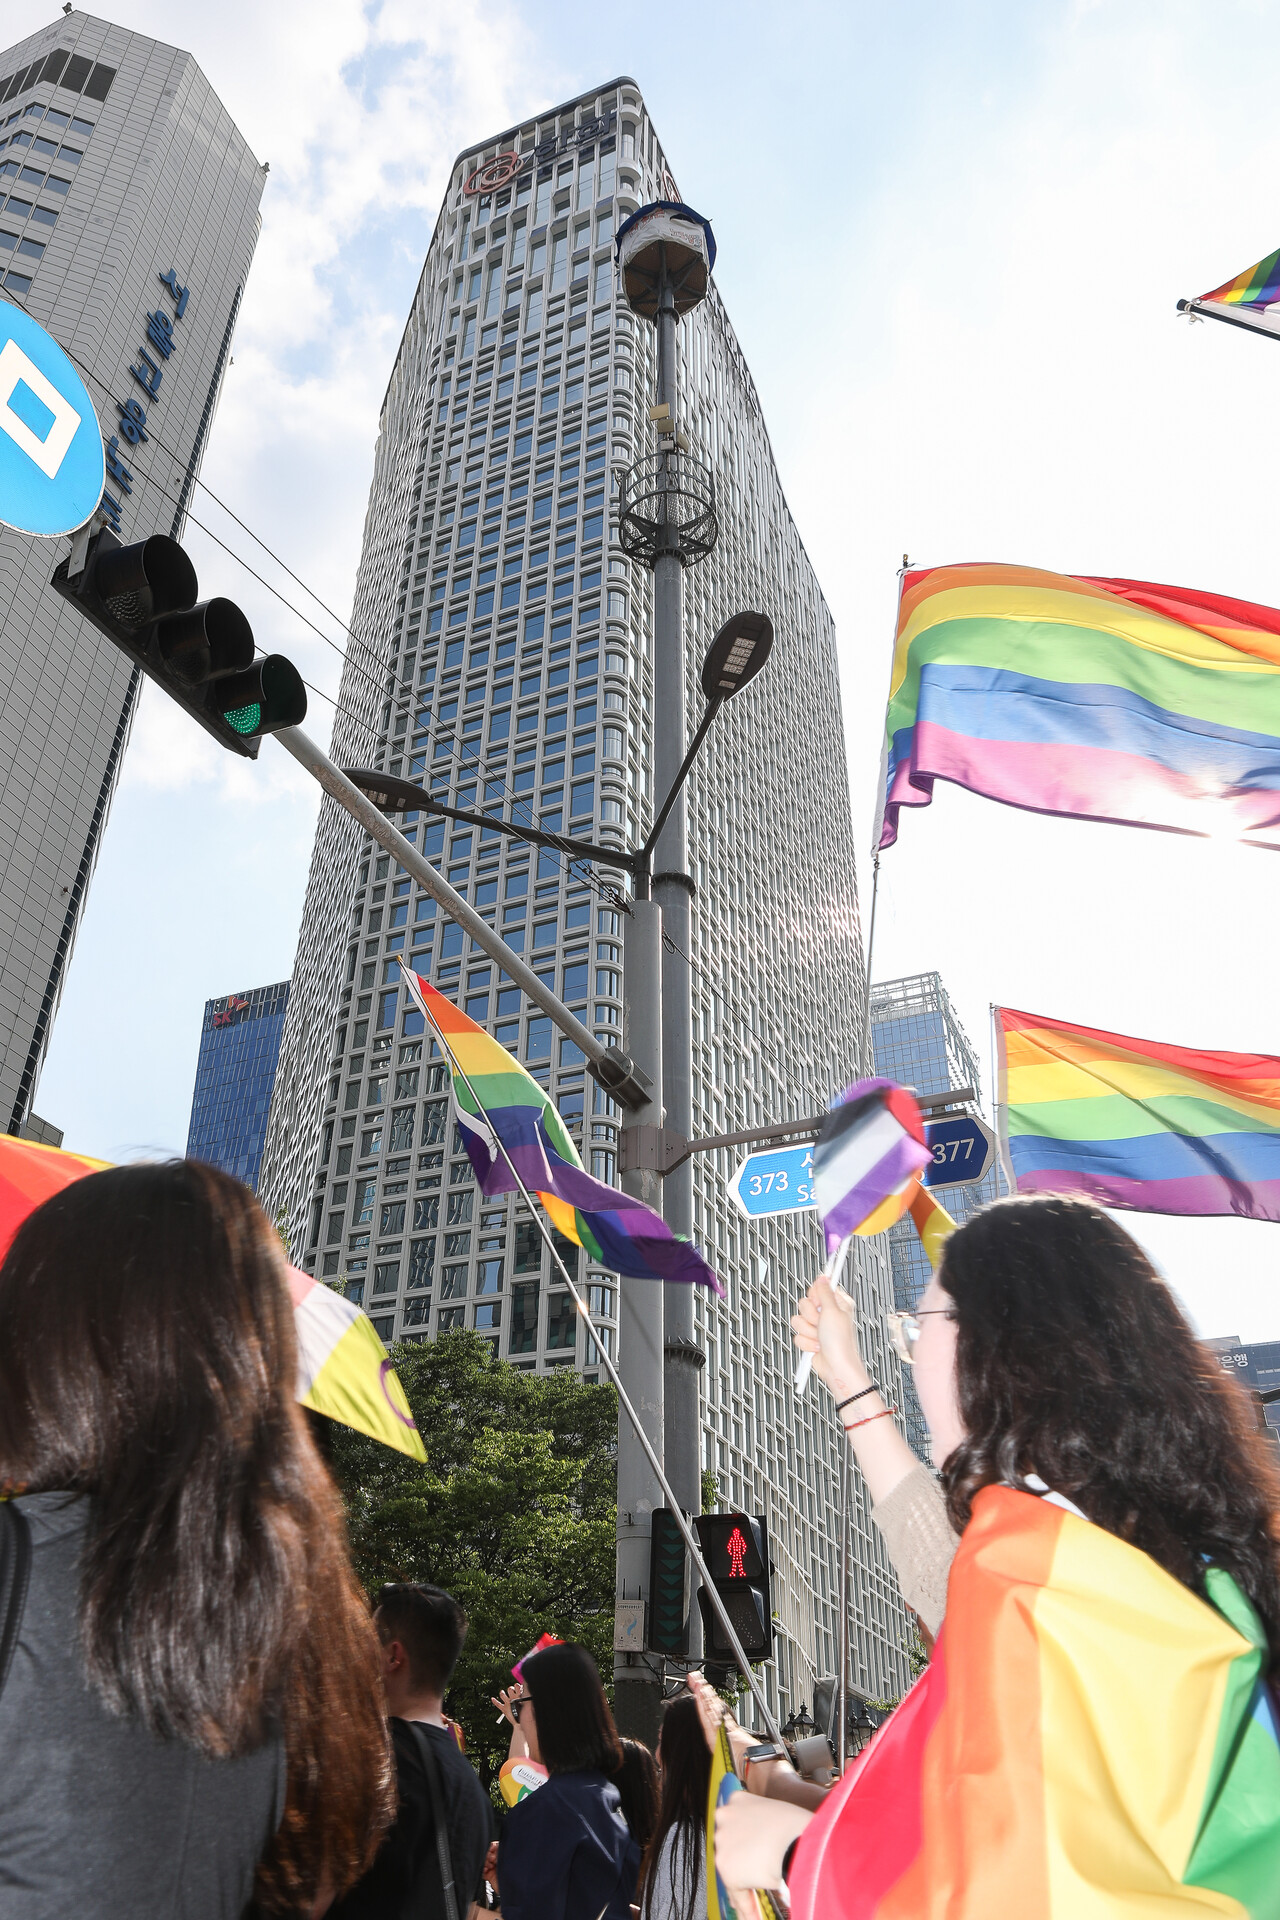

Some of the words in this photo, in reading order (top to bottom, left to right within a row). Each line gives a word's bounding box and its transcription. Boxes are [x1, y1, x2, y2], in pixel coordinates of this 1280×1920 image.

[212, 1009, 233, 1027] SK
[931, 1138, 975, 1164] 377
[749, 1170, 789, 1196] 373
[1219, 1353, 1248, 1368] 은행
